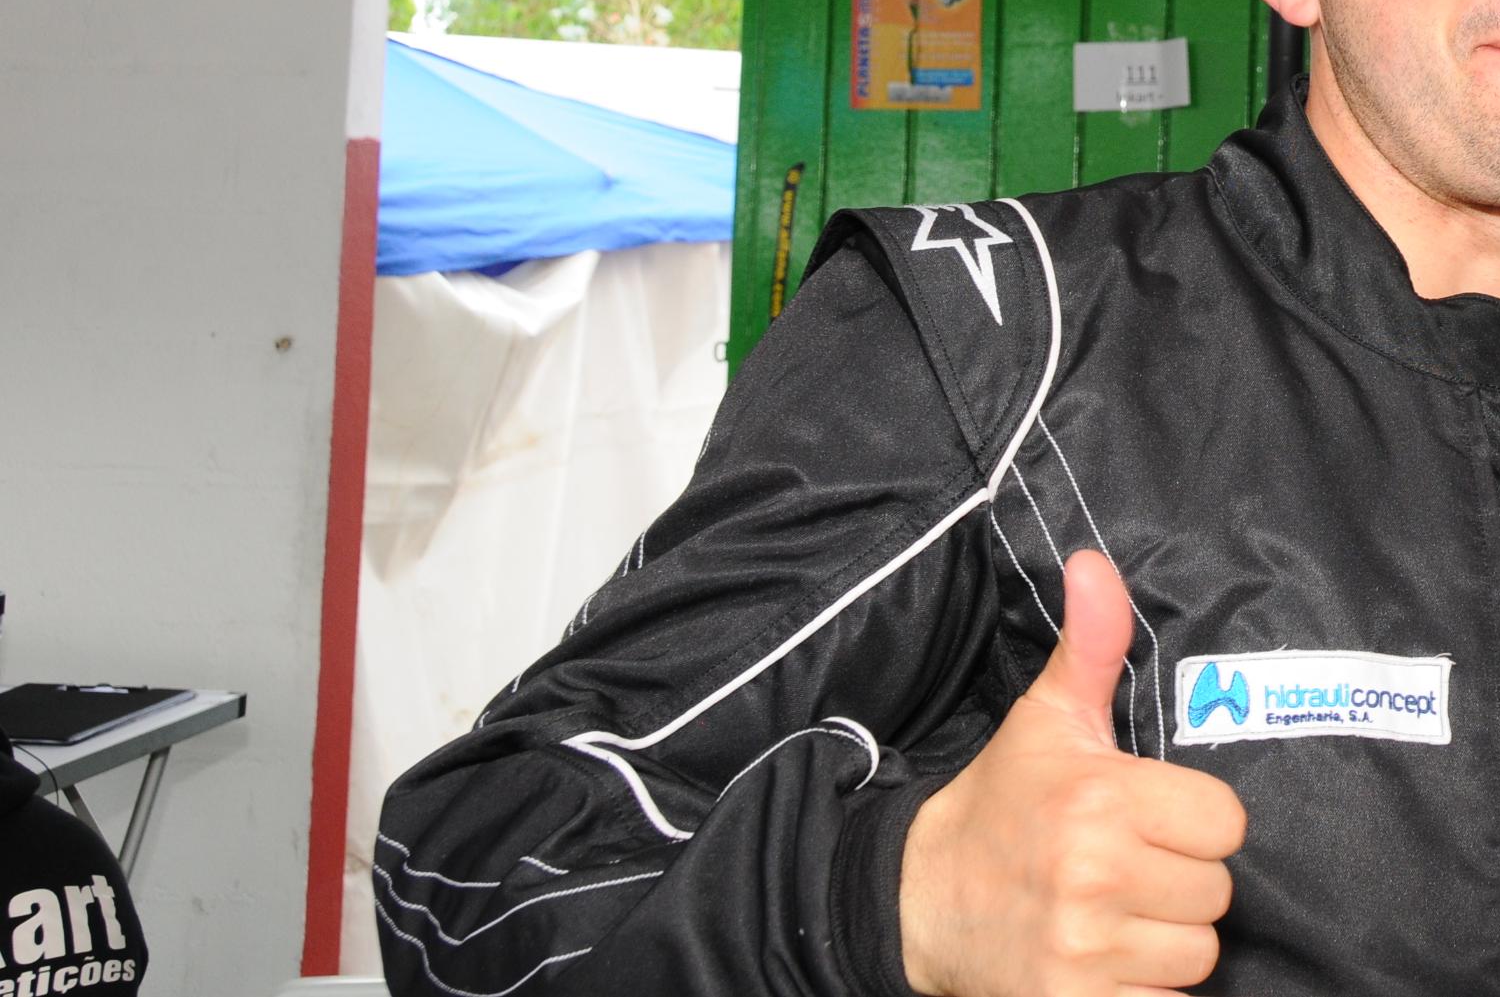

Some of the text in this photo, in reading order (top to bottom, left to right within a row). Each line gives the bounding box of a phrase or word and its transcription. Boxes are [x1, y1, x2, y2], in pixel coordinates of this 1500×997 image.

[1264, 683, 1437, 718] hidrauliconcept
[1265, 711, 1344, 726] Engenharia,
[0, 875, 126, 969] art
